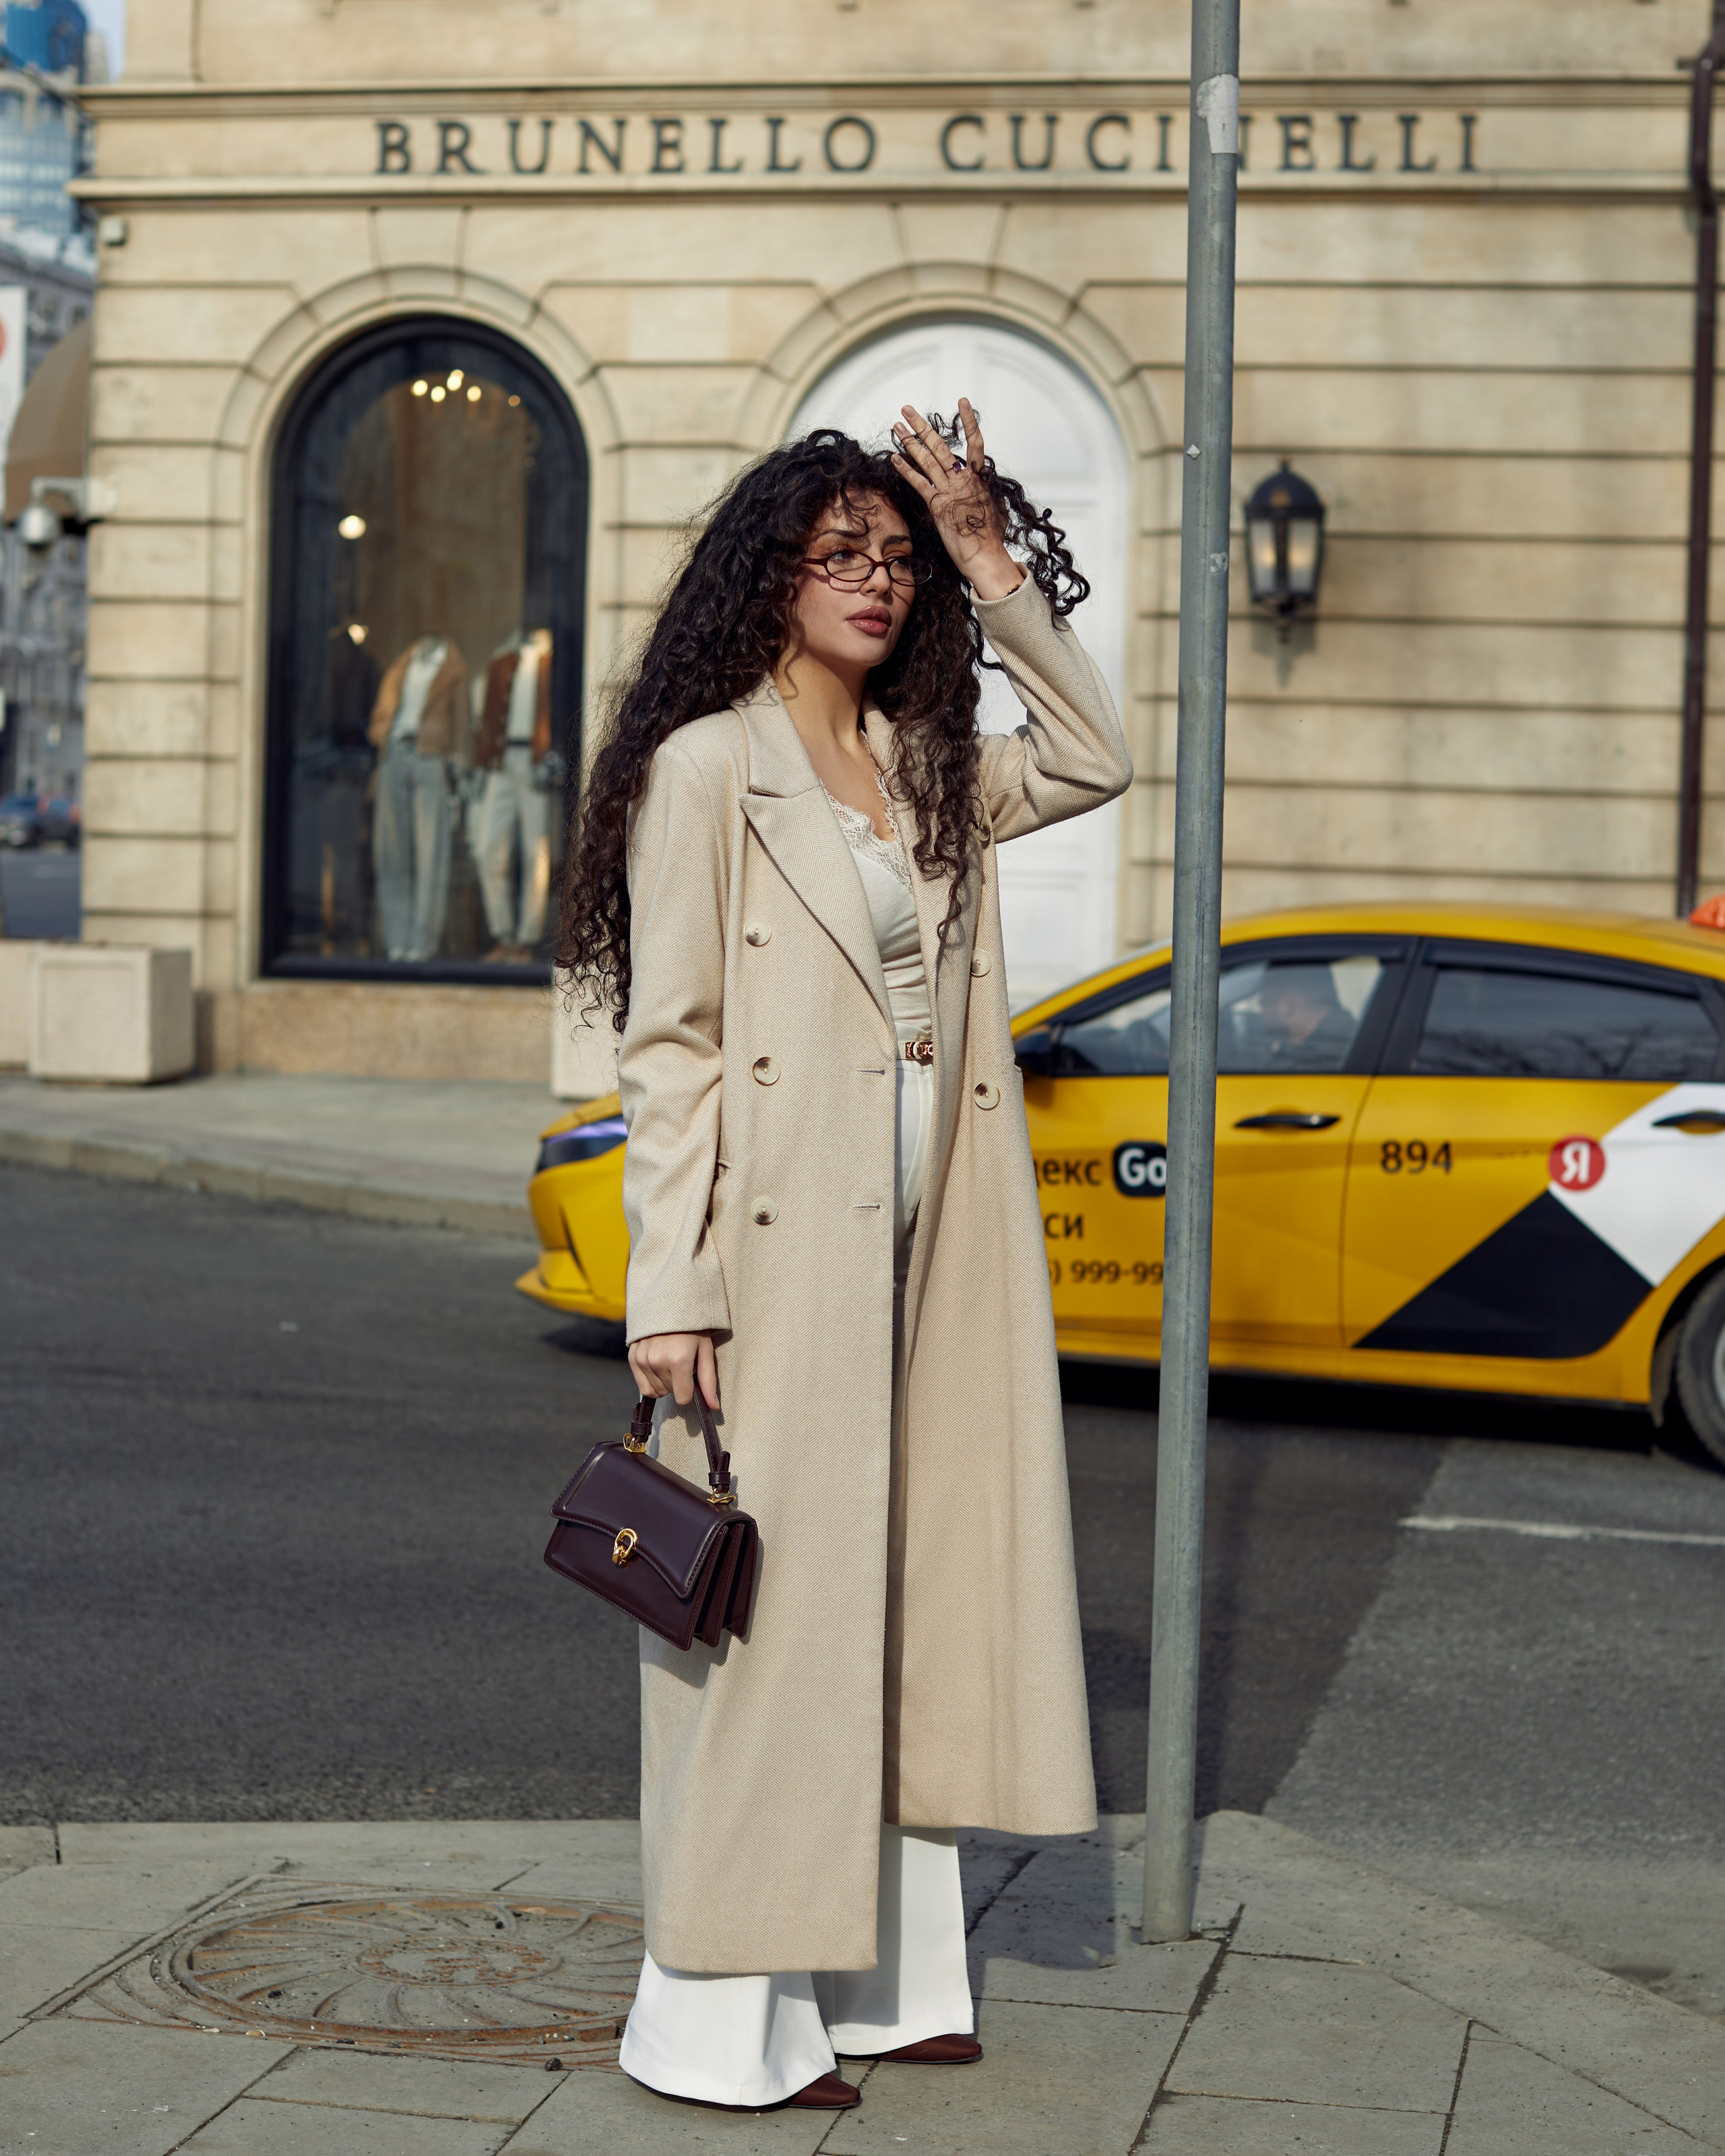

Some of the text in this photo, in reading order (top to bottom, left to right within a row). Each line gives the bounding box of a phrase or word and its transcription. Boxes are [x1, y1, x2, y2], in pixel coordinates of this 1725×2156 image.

[375, 116, 877, 174] BRUNELLO
[1034, 1159, 1102, 1191] екс
[1118, 1147, 1167, 1188] Go
[1381, 1140, 1453, 1174] 894
